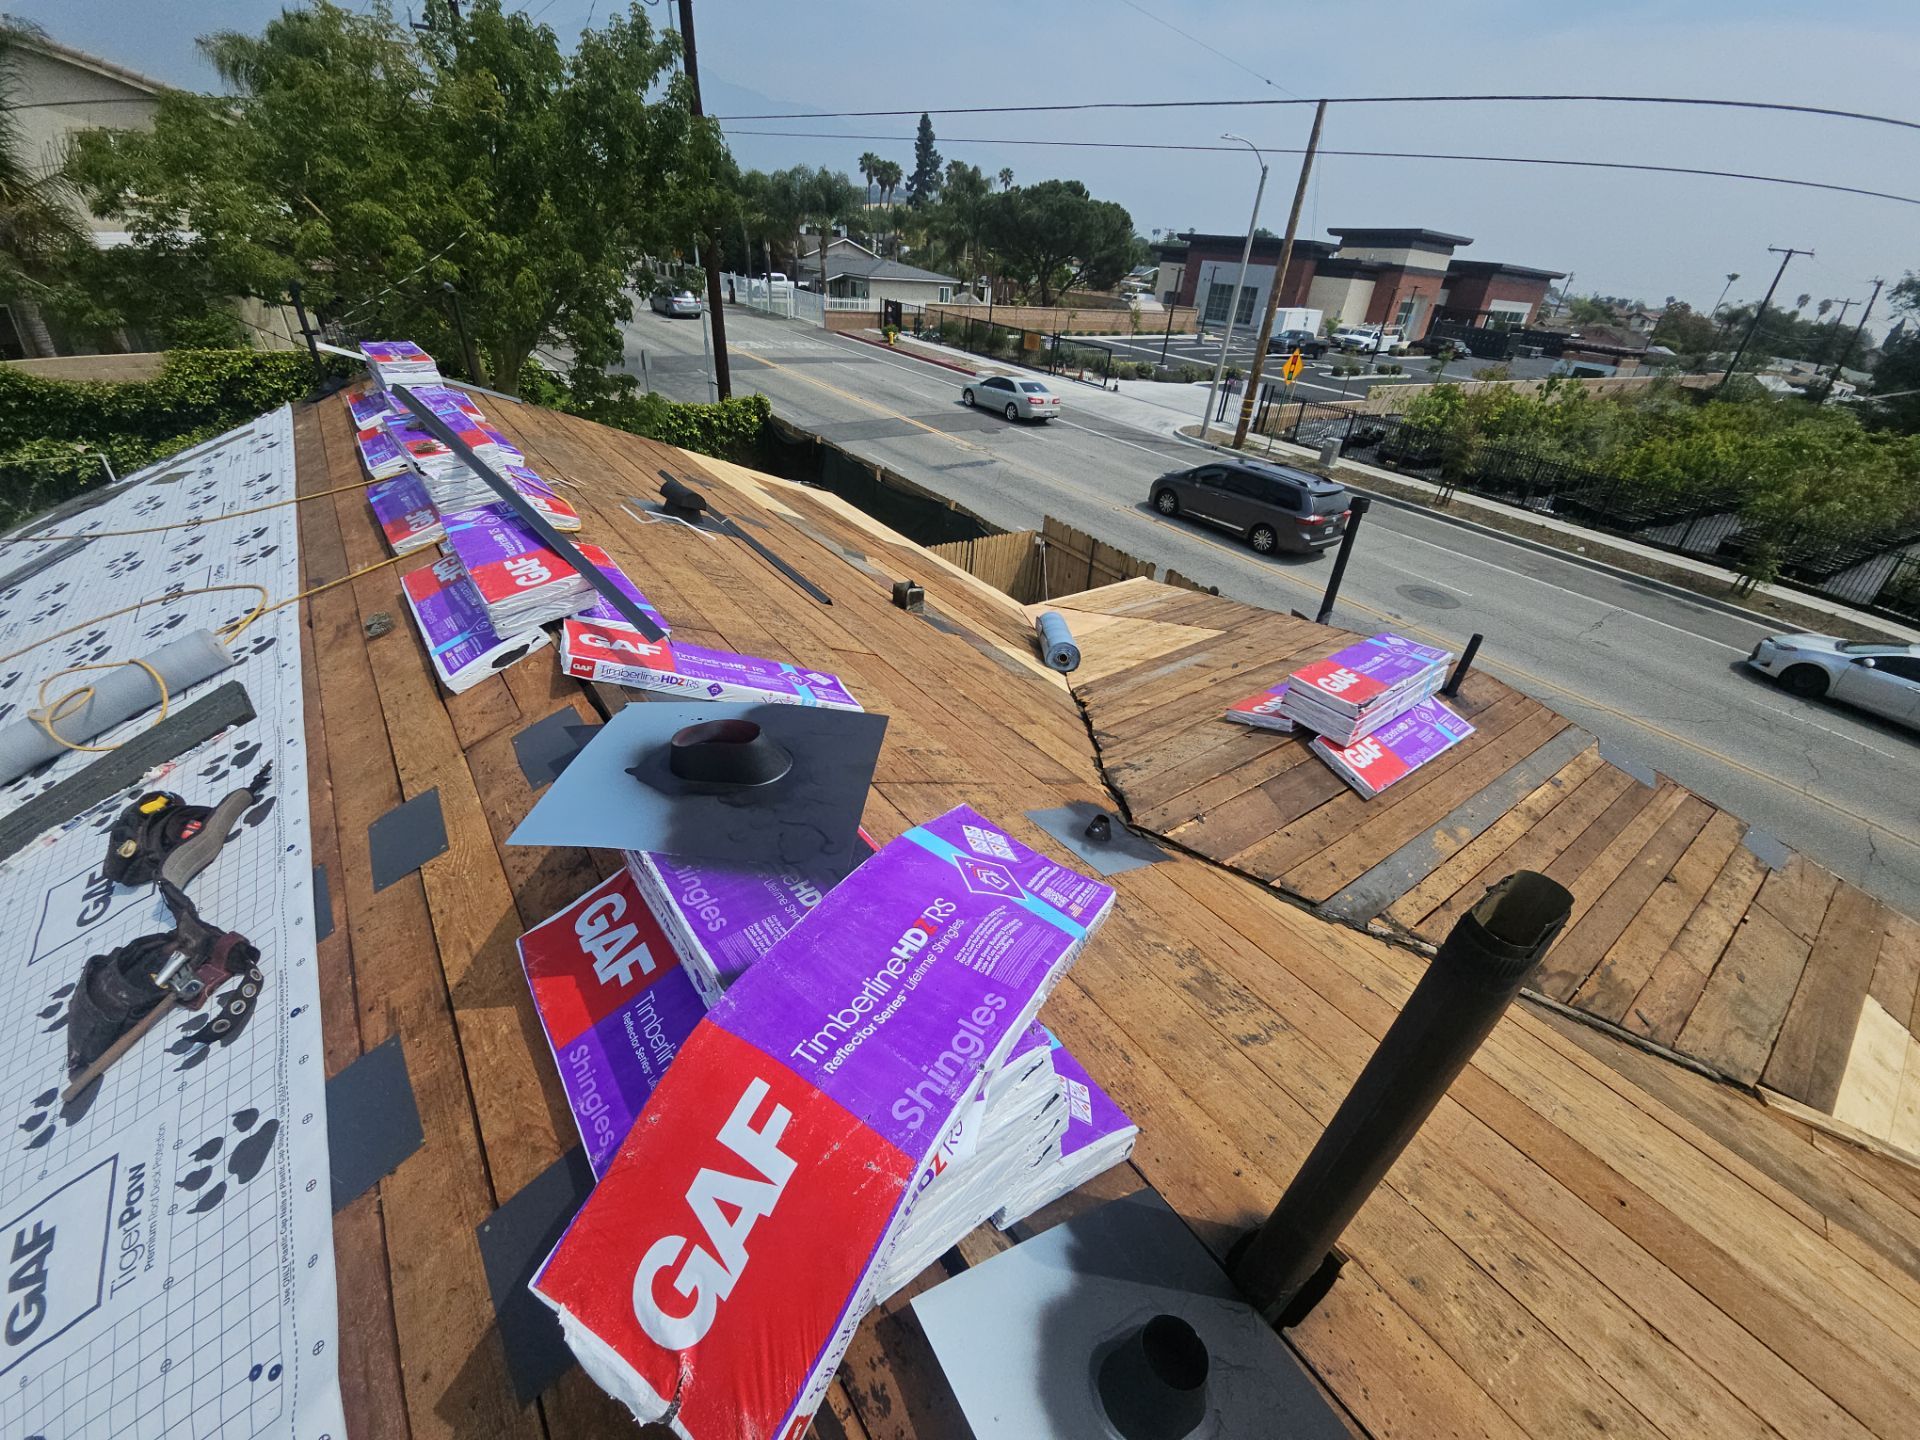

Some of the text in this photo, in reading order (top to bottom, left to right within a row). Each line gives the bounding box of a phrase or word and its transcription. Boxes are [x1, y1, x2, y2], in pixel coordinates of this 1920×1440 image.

[404, 509, 436, 532] GAF
[432, 556, 465, 583] GAF
[504, 557, 552, 587] GAF
[579, 633, 662, 657] GAF
[572, 663, 593, 673] GAF
[1318, 668, 1361, 693] GAF
[685, 679, 700, 689] RS
[1344, 736, 1384, 769] GAF
[923, 897, 957, 923] RS
[574, 892, 657, 988] GAF
[823, 1022, 878, 1075] Reflector
[932, 918, 966, 954] Shingles
[622, 1011, 640, 1051] Reflector
[635, 990, 677, 1072] Timberlin
[892, 992, 1007, 1130] Shingles
[569, 1044, 615, 1151] Shingles
[144, 1121, 168, 1273] Premium Roof Deck Protection
[279, 1220, 288, 1236] Cap
[633, 1076, 799, 1351] GAF
[110, 1162, 147, 1301] TigerPaw
[280, 1236, 289, 1264] Plastic
[4, 1219, 57, 1347] GAF
[281, 1263, 291, 1288] ONLY
